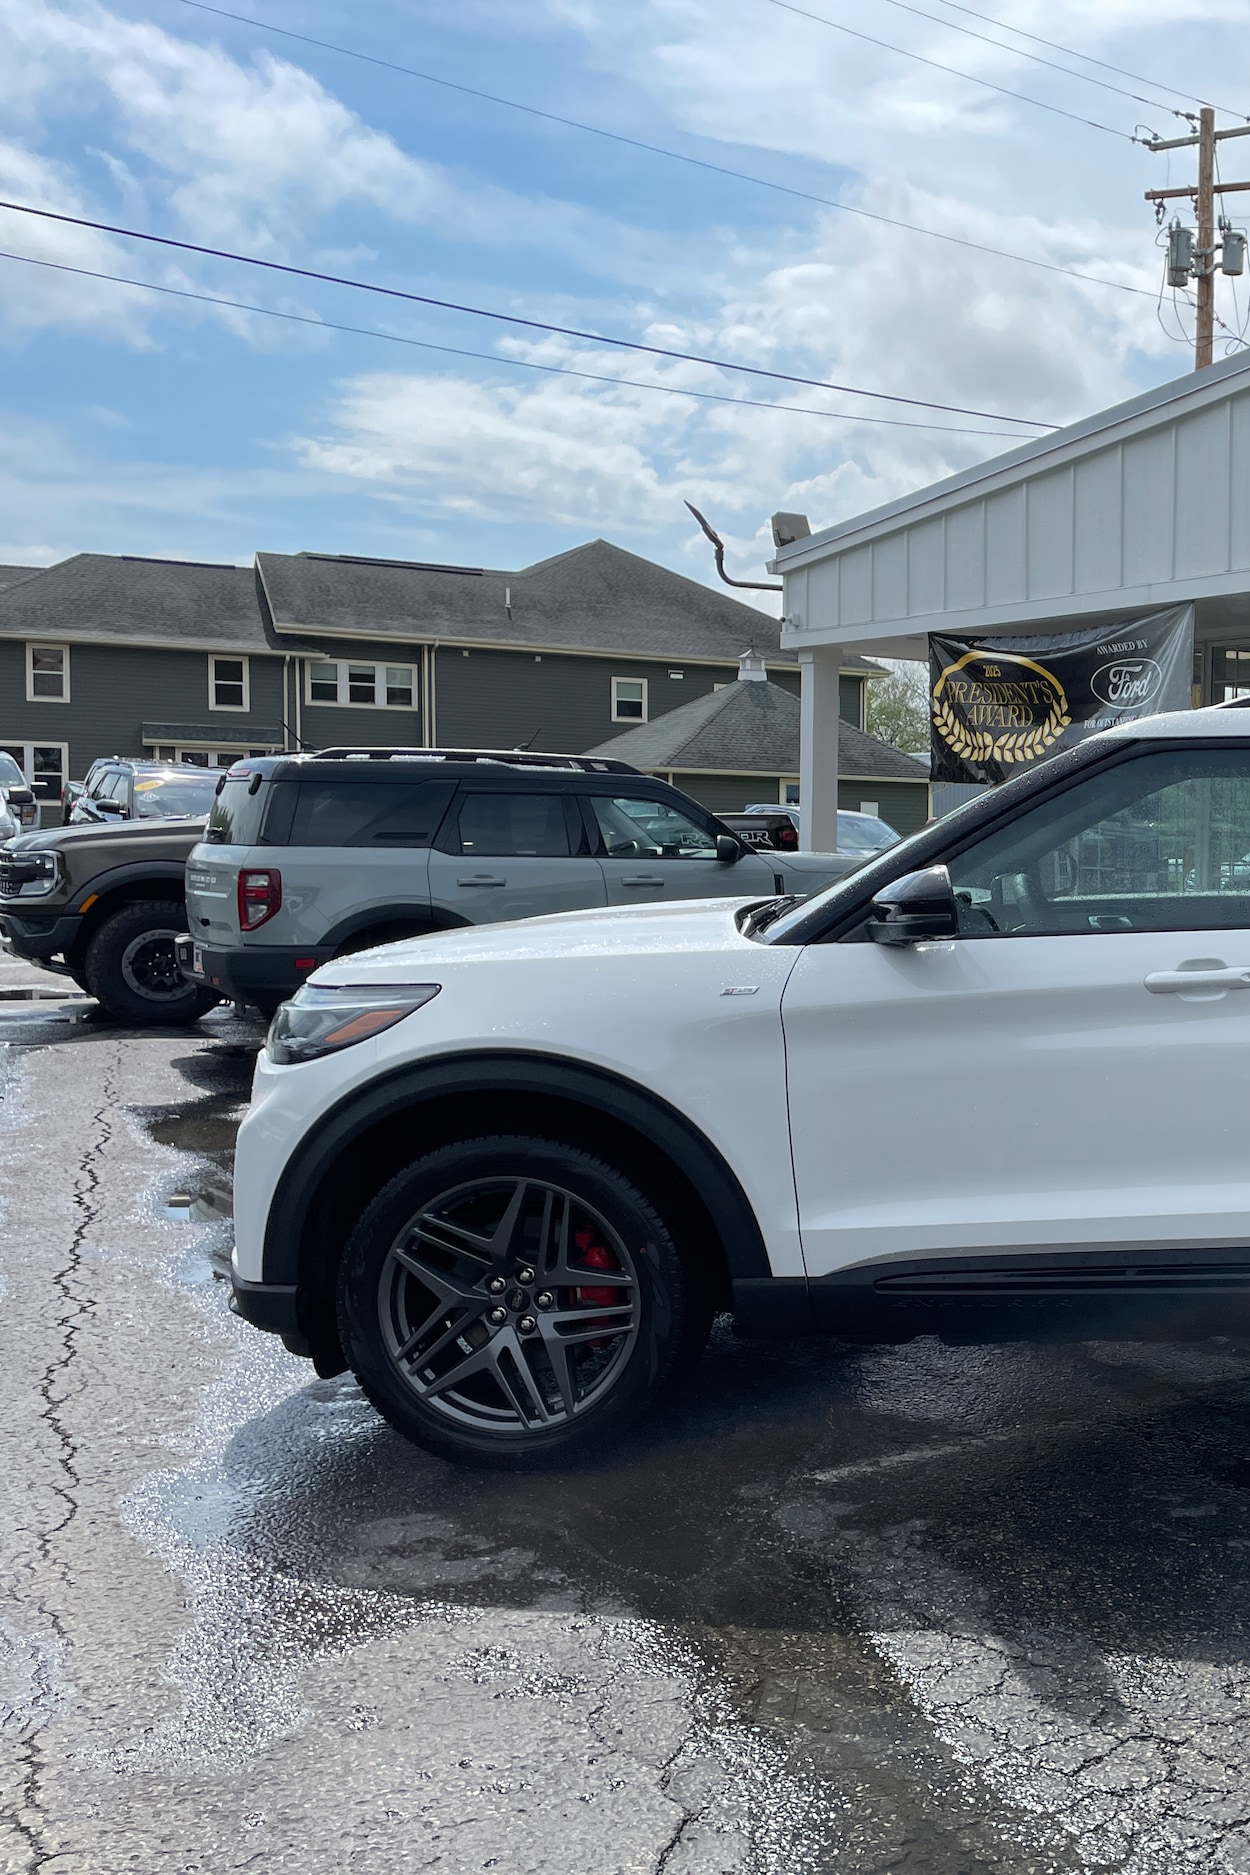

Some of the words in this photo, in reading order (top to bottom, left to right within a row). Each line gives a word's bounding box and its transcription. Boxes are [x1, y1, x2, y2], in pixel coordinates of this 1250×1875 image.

[1096, 640, 1136, 656] AWARDED
[1136, 639, 1149, 650] BY
[982, 664, 1002, 678] 2025
[1108, 665, 1153, 701] Ford
[946, 680, 1054, 704] PRESIDENT'S
[965, 704, 1034, 728] AWARD
